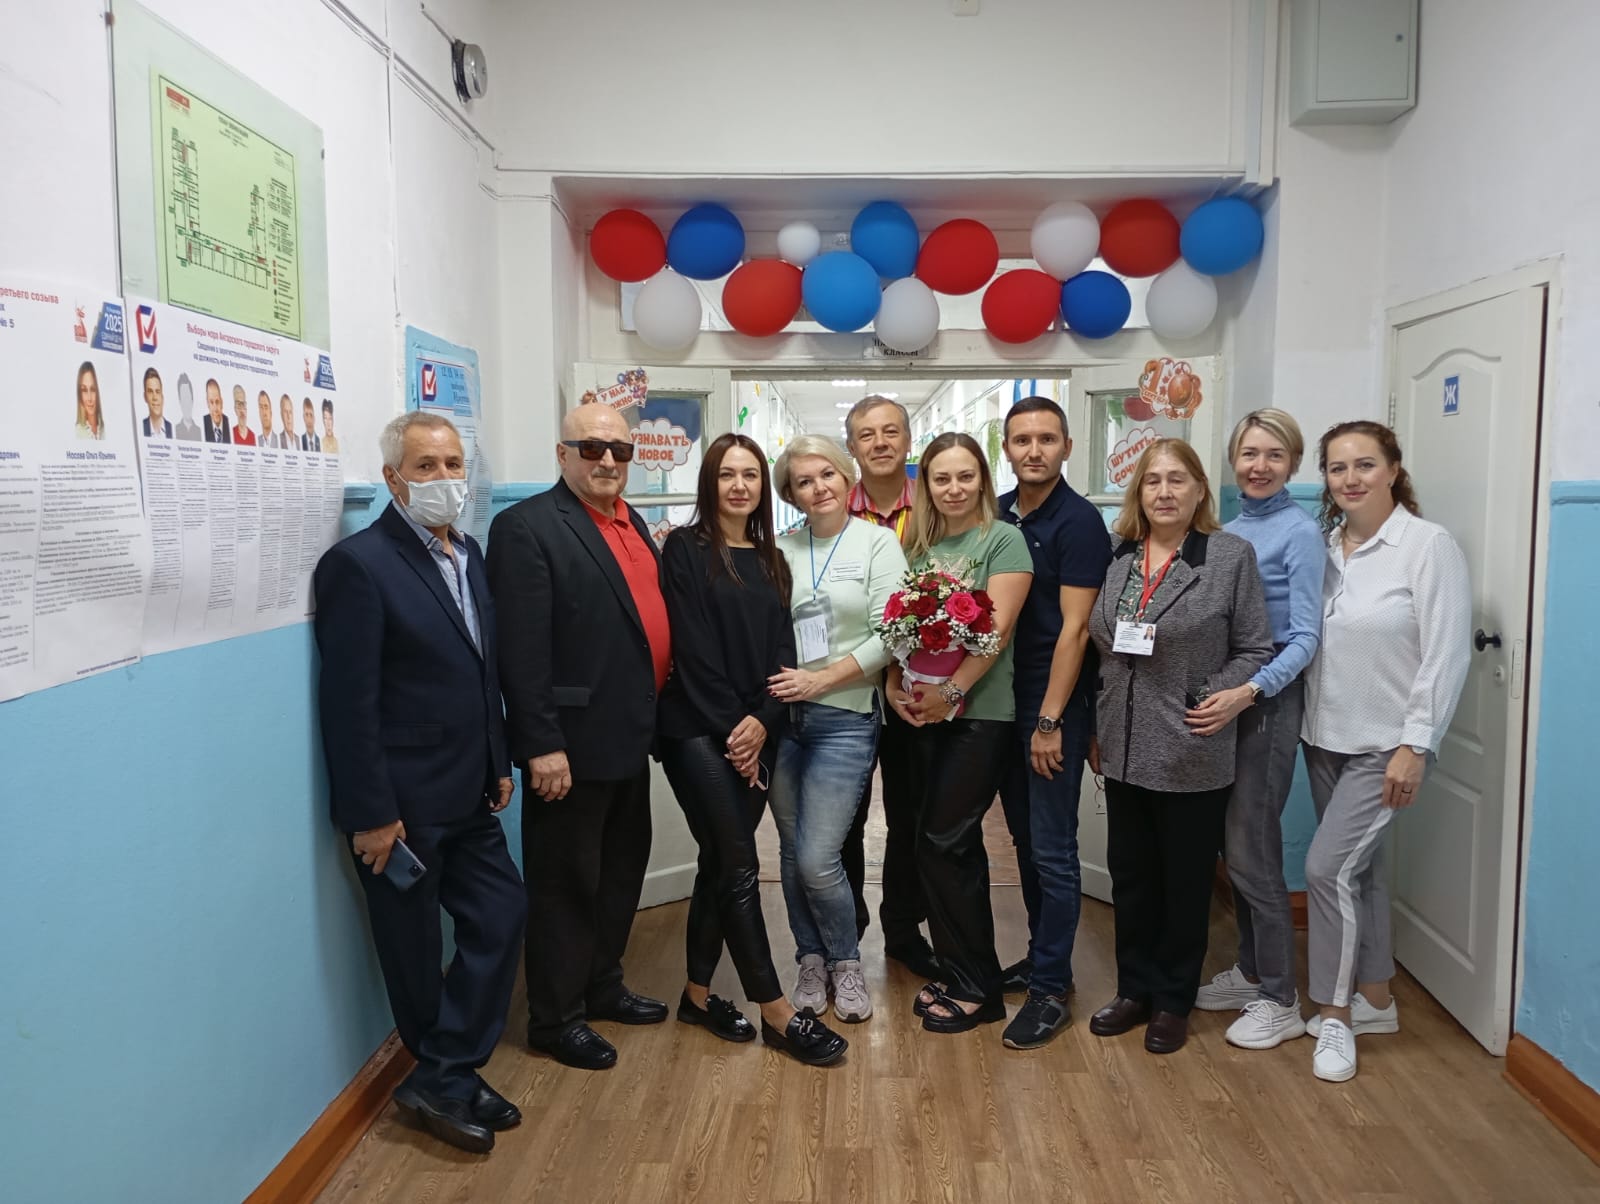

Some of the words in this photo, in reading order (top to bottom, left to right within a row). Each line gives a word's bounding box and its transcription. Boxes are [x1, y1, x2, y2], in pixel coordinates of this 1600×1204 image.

[0, 288, 29, 299] ретьего
[31, 292, 59, 304] созыва
[105, 312, 122, 333] 2025
[600, 393, 607, 402] У
[609, 385, 625, 398] НАС
[611, 395, 633, 408] ОЖНО
[1445, 383, 1457, 406] Ж
[631, 433, 689, 446] УЗНАВАТЬ
[638, 448, 674, 461] НОВОЕ
